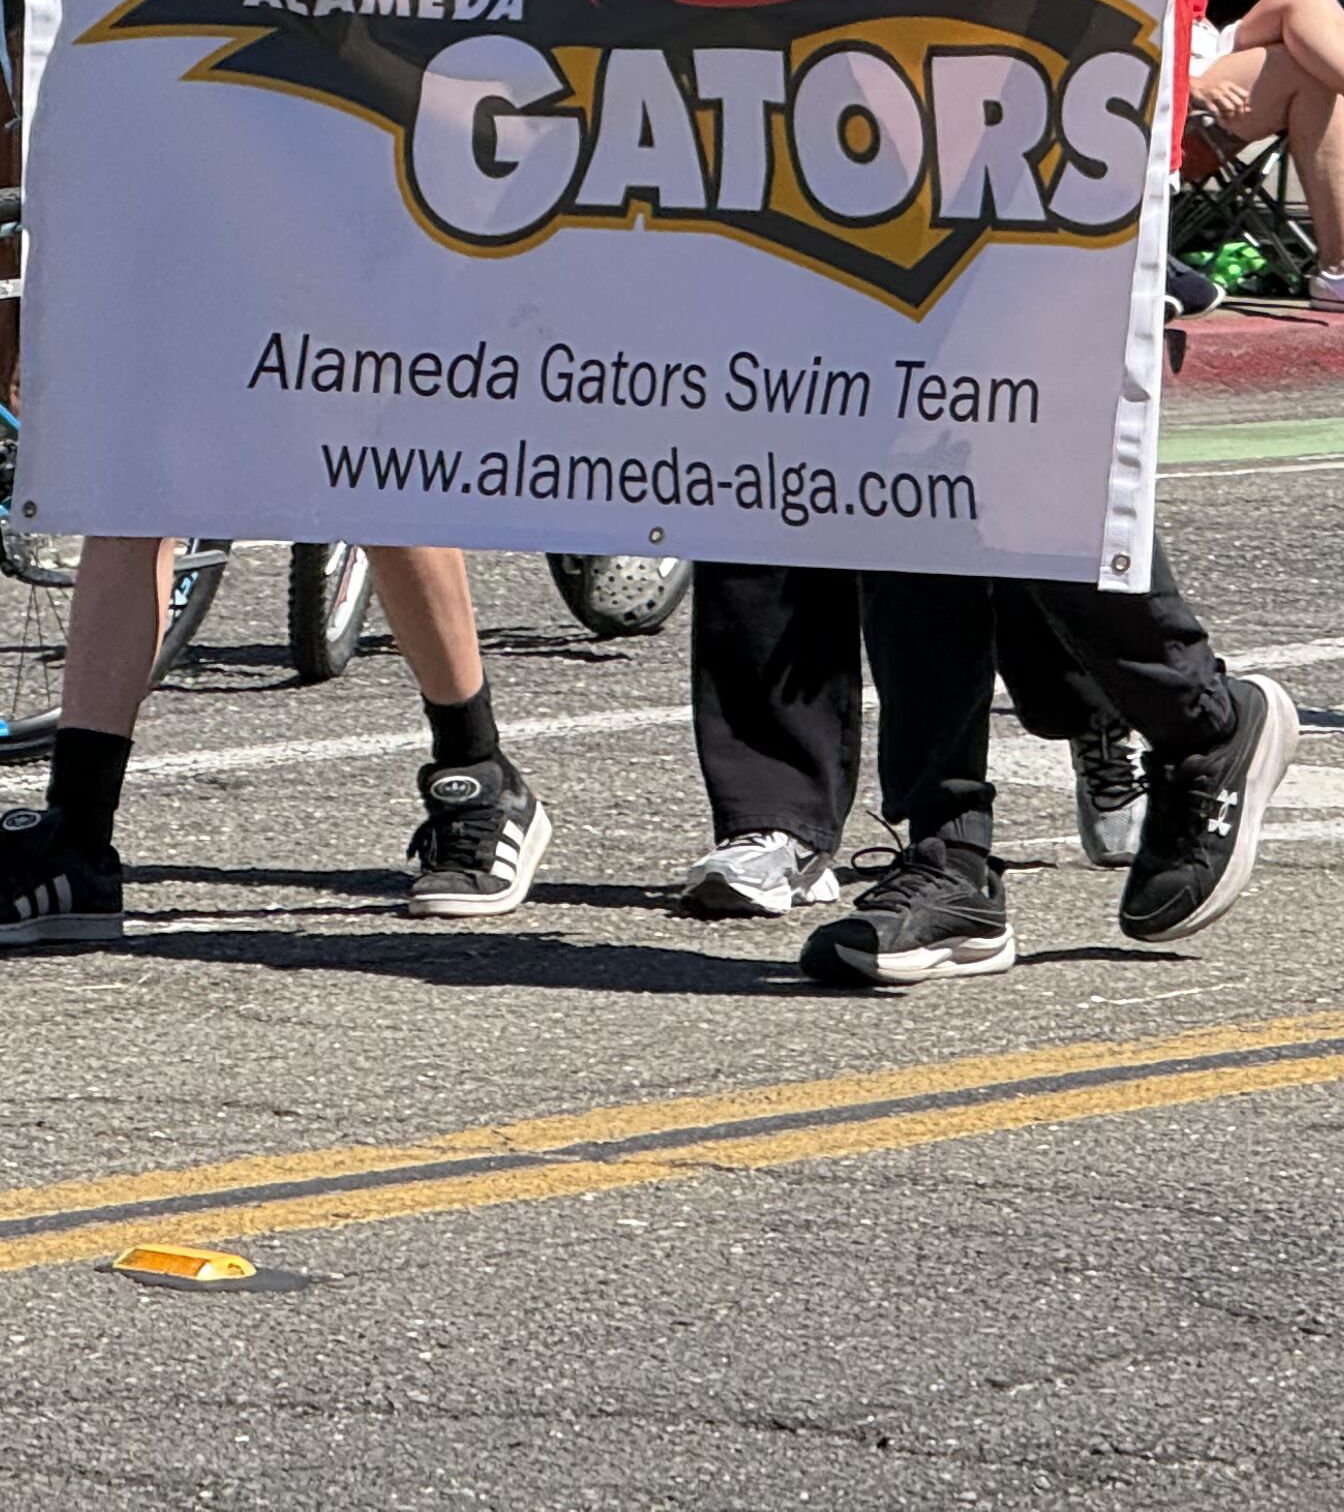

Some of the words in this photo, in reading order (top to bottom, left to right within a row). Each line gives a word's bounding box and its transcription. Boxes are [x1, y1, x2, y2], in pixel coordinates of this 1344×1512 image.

[411, 34, 1154, 238] GATORS
[247, 332, 520, 400] Alameda
[539, 342, 707, 410] Gators
[724, 350, 871, 418] Swim
[894, 359, 1039, 423] Team
[321, 438, 979, 527] www.alameda-alga.com
